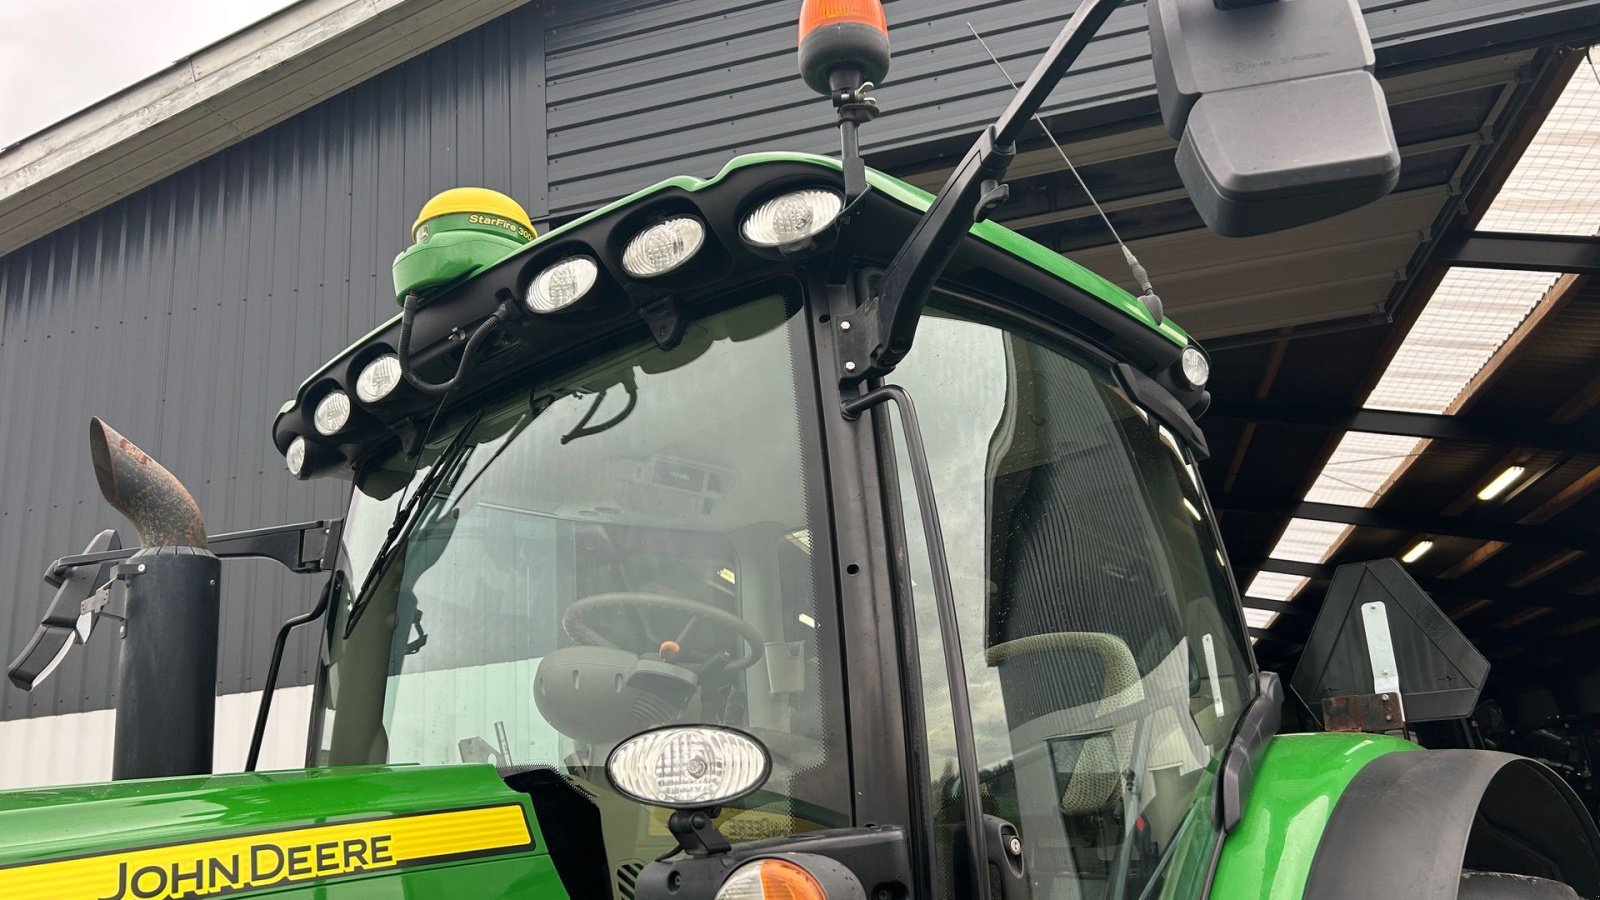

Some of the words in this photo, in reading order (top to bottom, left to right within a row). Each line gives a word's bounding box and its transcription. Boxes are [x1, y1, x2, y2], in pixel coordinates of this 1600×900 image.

[469, 214, 517, 232] StarFire
[518, 227, 534, 241] 300
[98, 854, 240, 900] JOHN
[250, 835, 393, 881] DEERE
